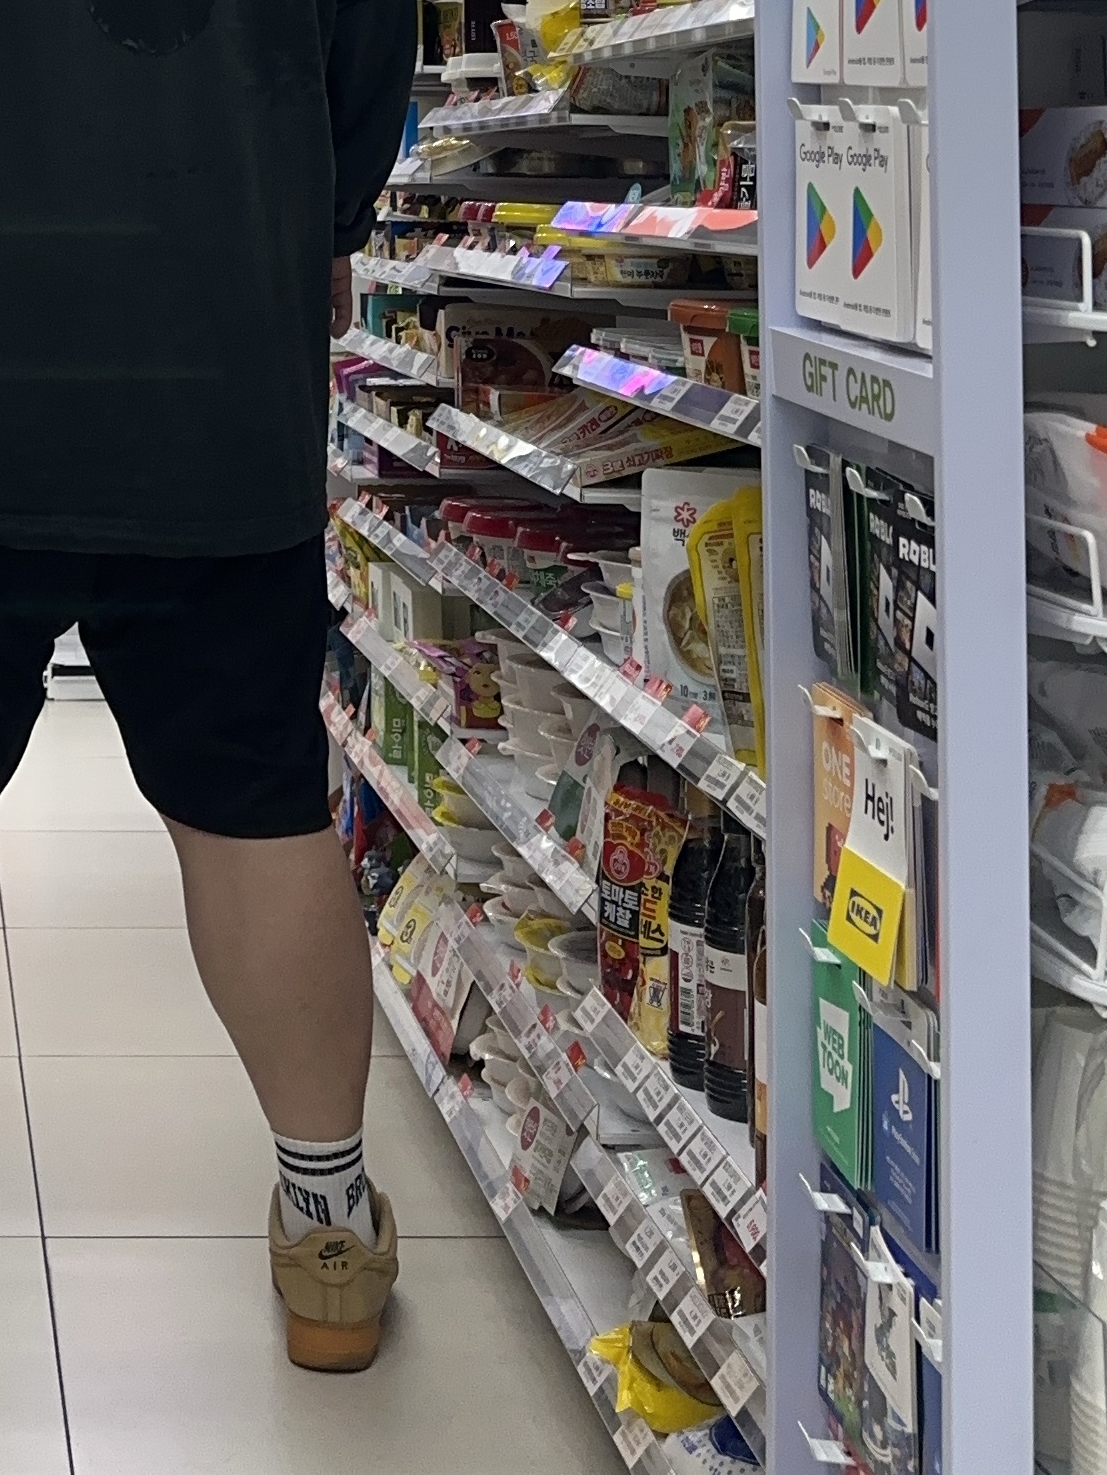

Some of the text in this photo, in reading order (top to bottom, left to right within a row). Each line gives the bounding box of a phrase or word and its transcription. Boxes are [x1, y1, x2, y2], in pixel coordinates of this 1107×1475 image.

[800, 143, 843, 171] Google Play
[846, 146, 888, 172] Google Play
[802, 352, 896, 423] GIFT CARD
[821, 740, 851, 785] ONE
[822, 778, 852, 817] store
[864, 777, 894, 841] Hej!
[599, 882, 639, 910] 토마토
[850, 897, 880, 935] IKEA
[822, 1022, 846, 1060] WEB
[820, 1044, 850, 1090] TOON
[321, 1261, 348, 1271] AIR
